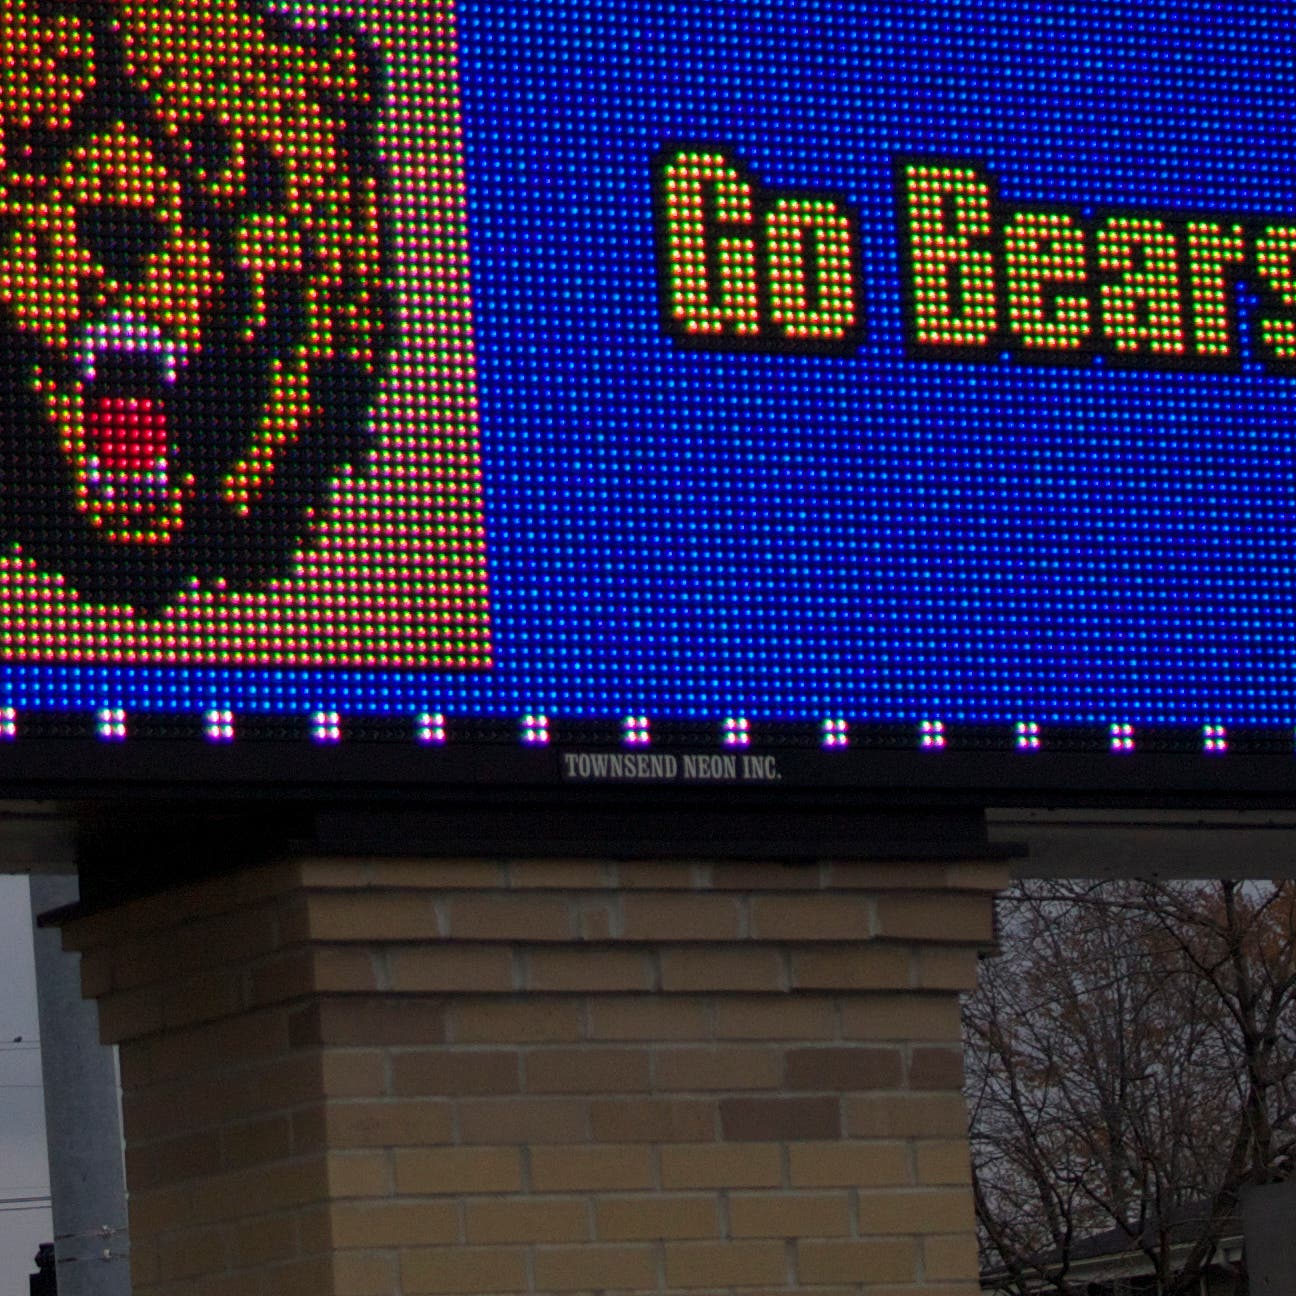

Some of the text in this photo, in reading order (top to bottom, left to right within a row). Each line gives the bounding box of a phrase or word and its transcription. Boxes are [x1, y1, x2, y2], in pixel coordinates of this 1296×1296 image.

[664, 152, 856, 340] Go
[565, 753, 782, 780] TOWNSEND NEON INC.
